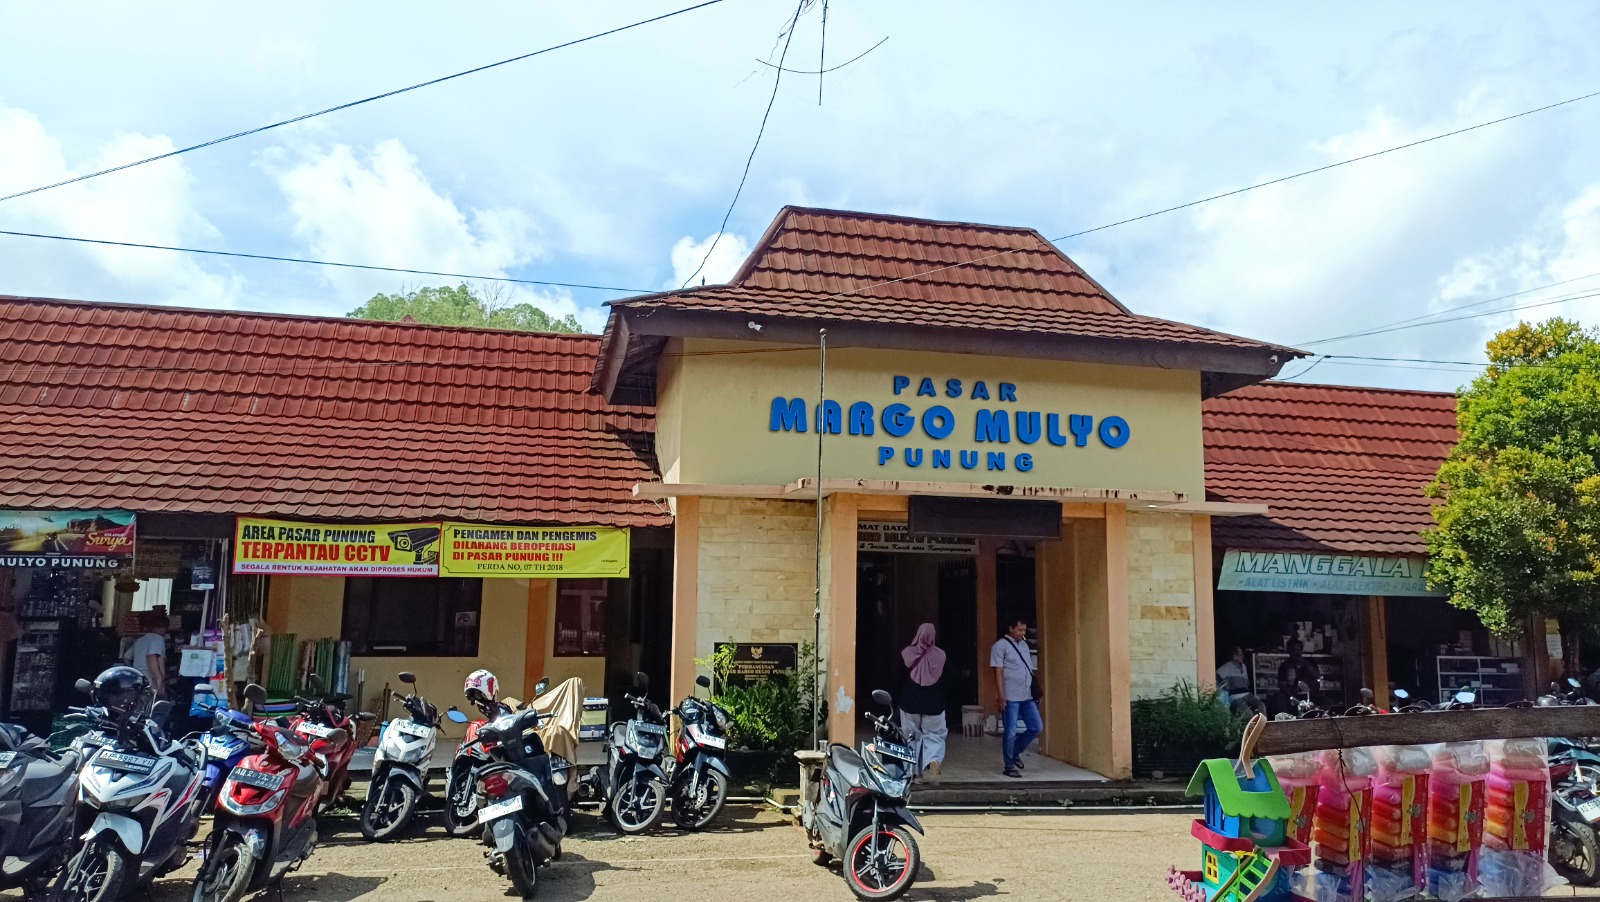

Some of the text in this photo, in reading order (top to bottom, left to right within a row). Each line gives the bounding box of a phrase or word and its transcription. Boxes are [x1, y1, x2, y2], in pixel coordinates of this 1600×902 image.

[893, 376, 1017, 401] PASAR
[769, 396, 1131, 448] MARGO MULYO
[878, 446, 1034, 471] PUNUNG
[86, 532, 132, 551] Surya
[242, 525, 375, 543] AREA PASAR PUNUNG
[453, 529, 597, 541] PENGAMEN DAN PENGEMIS
[242, 541, 390, 562] TERPANTAU CCTV
[453, 541, 576, 551] DILARANG BEROPERASI
[51, 558, 118, 568] PUNUNG
[453, 552, 563, 562] DI PASAR PUNUNG !!!
[1235, 551, 1412, 578] MANGGALA
[1244, 578, 1270, 587] ALAT
[1271, 578, 1309, 589] LISTRIK
